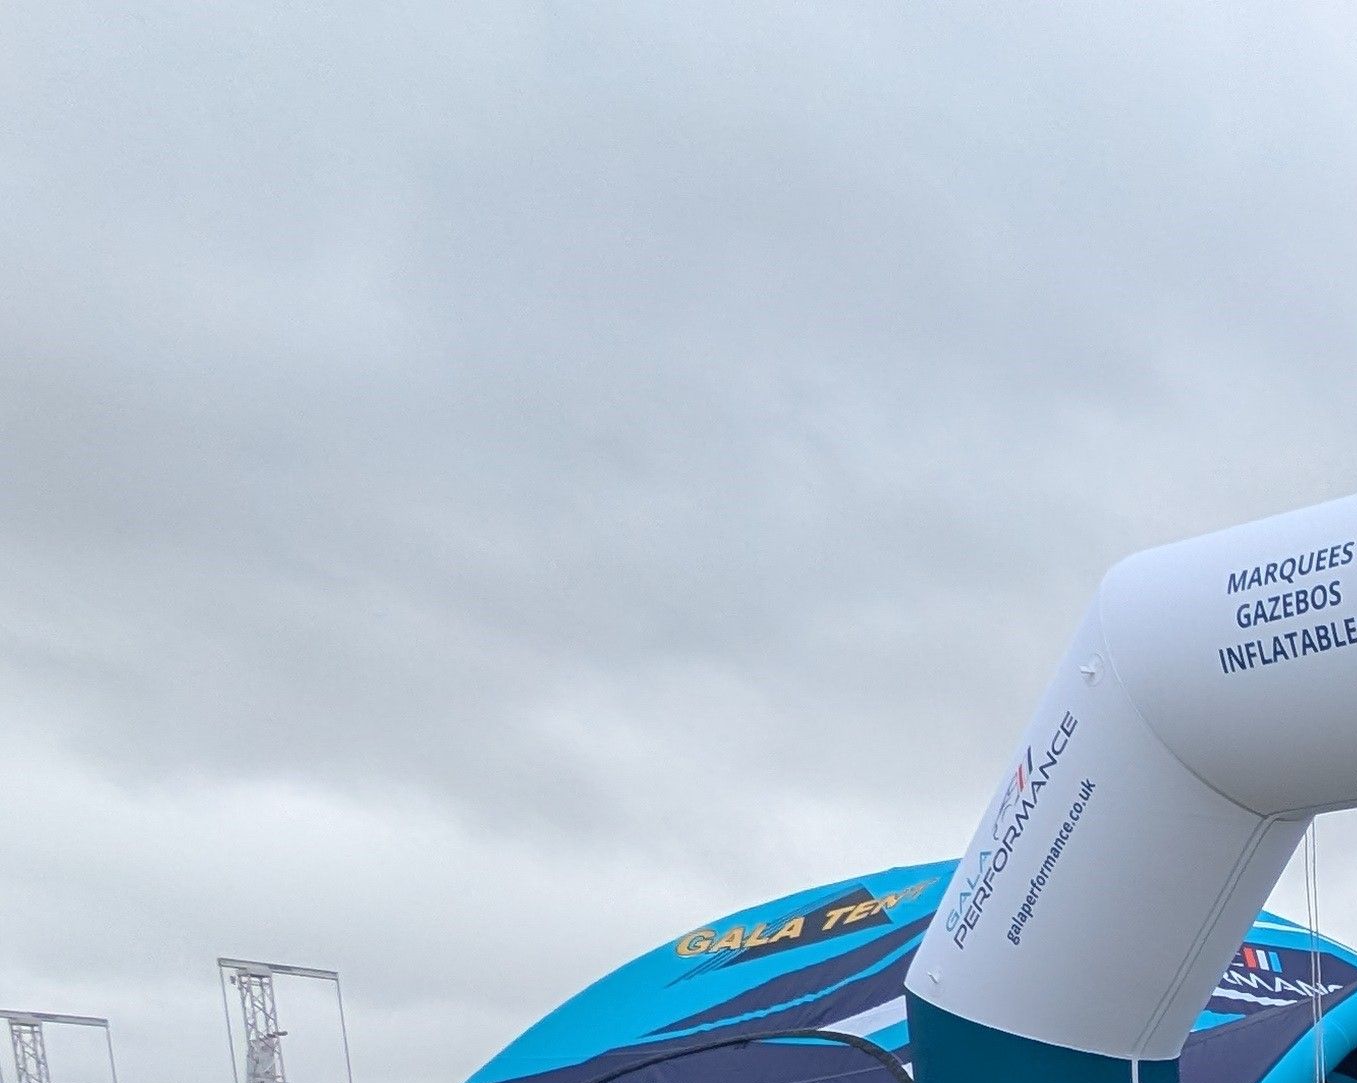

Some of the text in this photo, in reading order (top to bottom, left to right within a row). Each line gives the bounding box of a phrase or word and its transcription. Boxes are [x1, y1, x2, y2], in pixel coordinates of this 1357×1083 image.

[1227, 541, 1356, 595] MARQUEES
[1236, 580, 1342, 629] GAZEBOS
[954, 710, 1078, 949] PERFORMANCE
[1006, 777, 1096, 946] galaperformance.co.uk
[675, 917, 806, 958] GALA
